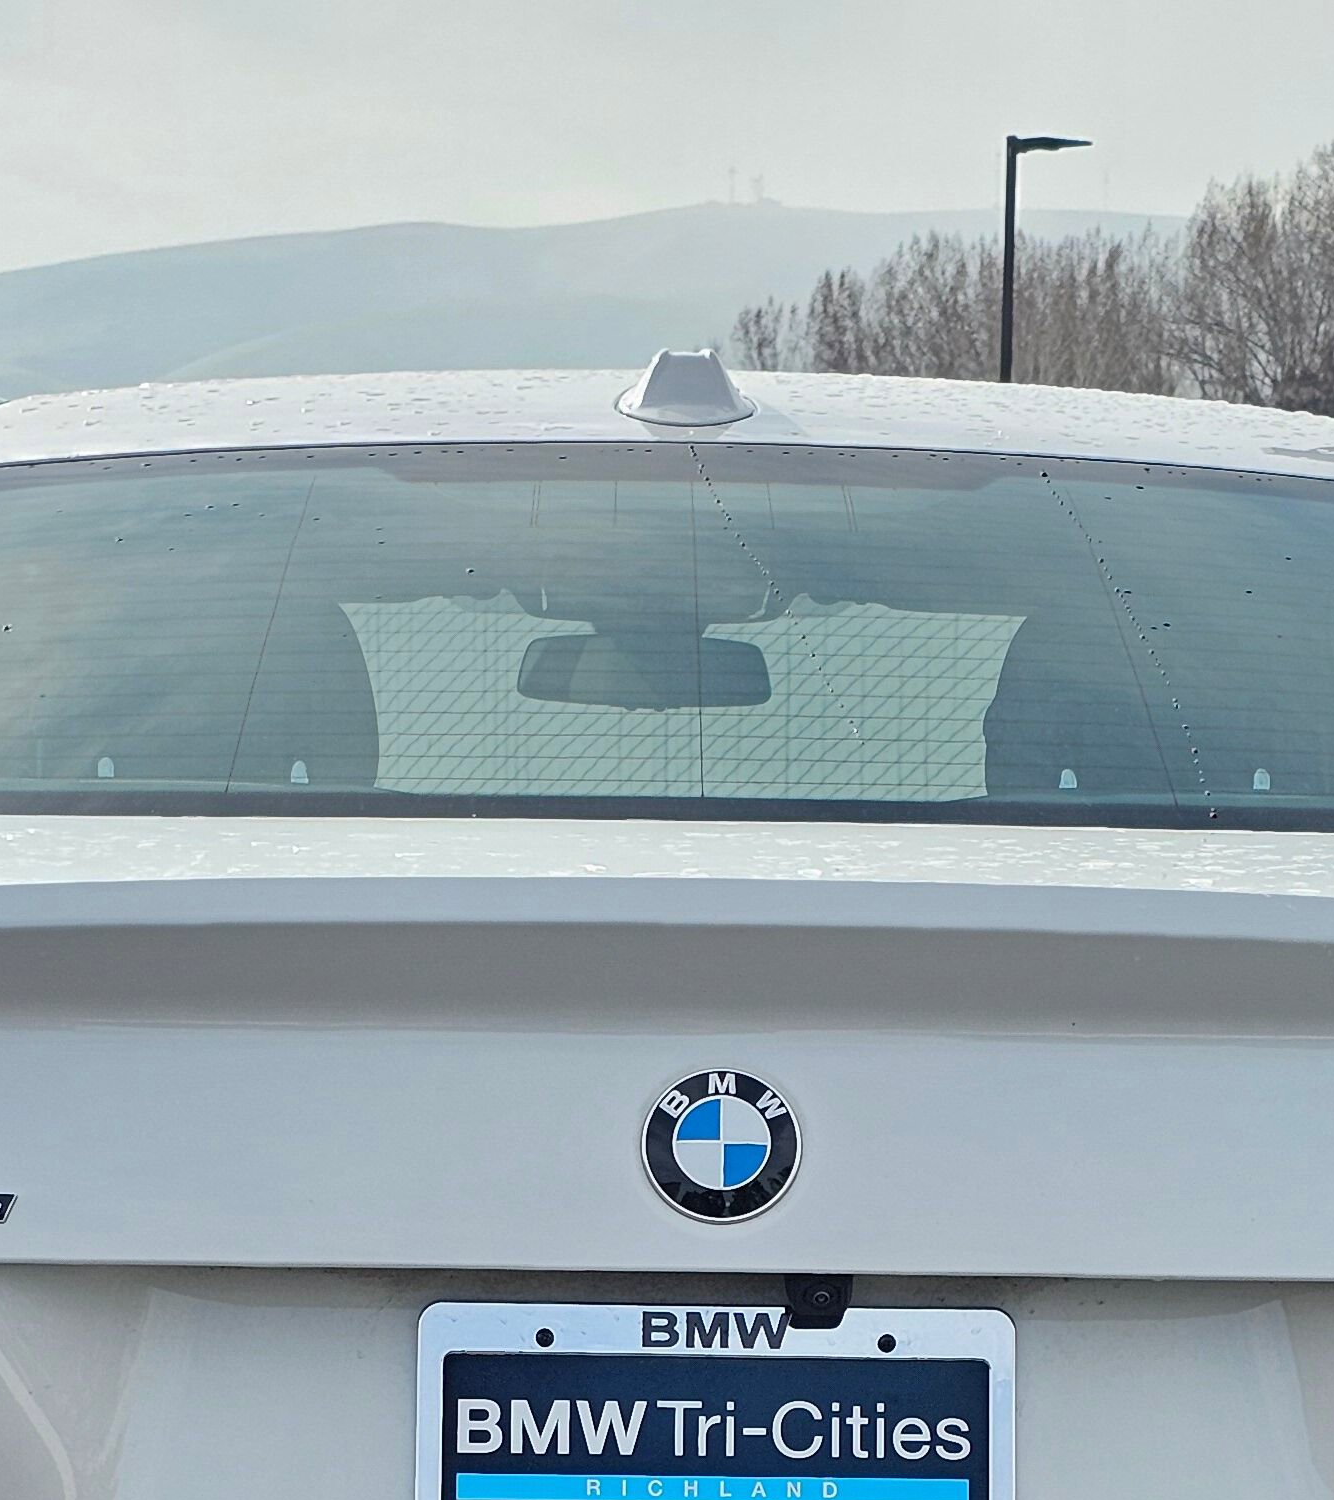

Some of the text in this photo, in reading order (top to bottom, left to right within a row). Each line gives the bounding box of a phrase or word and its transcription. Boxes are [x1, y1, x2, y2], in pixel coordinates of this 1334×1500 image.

[659, 1073, 787, 1119] BMW
[641, 1311, 789, 1350] BMW
[456, 1398, 972, 1461] BMW Tri-Cities
[586, 1480, 840, 1499] RICHLAND
